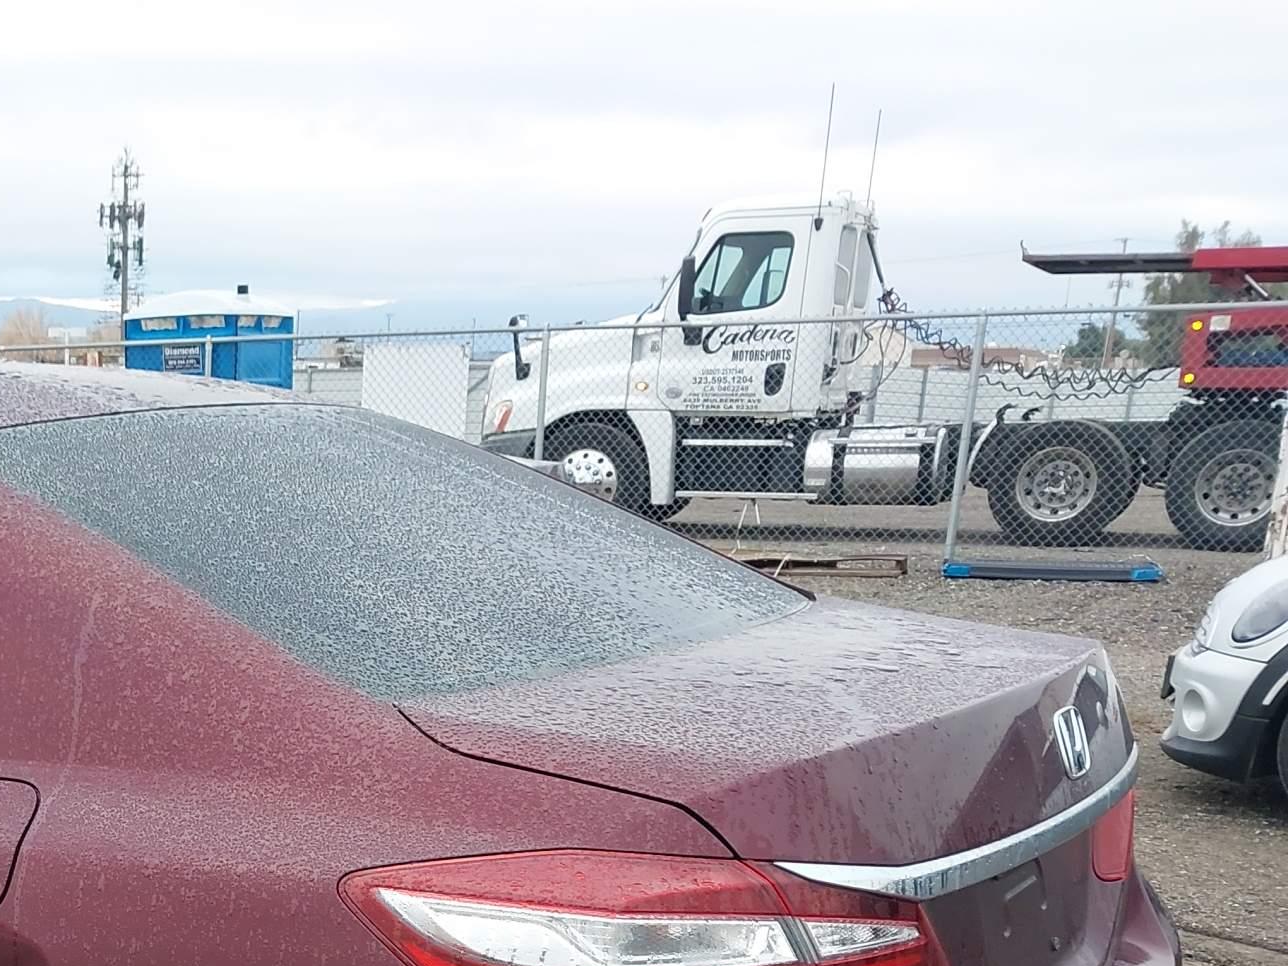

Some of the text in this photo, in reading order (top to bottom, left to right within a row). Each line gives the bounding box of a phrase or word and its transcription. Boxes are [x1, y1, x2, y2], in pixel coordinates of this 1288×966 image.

[702, 324, 796, 354] Cadena
[731, 349, 792, 362] MOTORSPORTS
[692, 375, 753, 385] 323.595.1204
